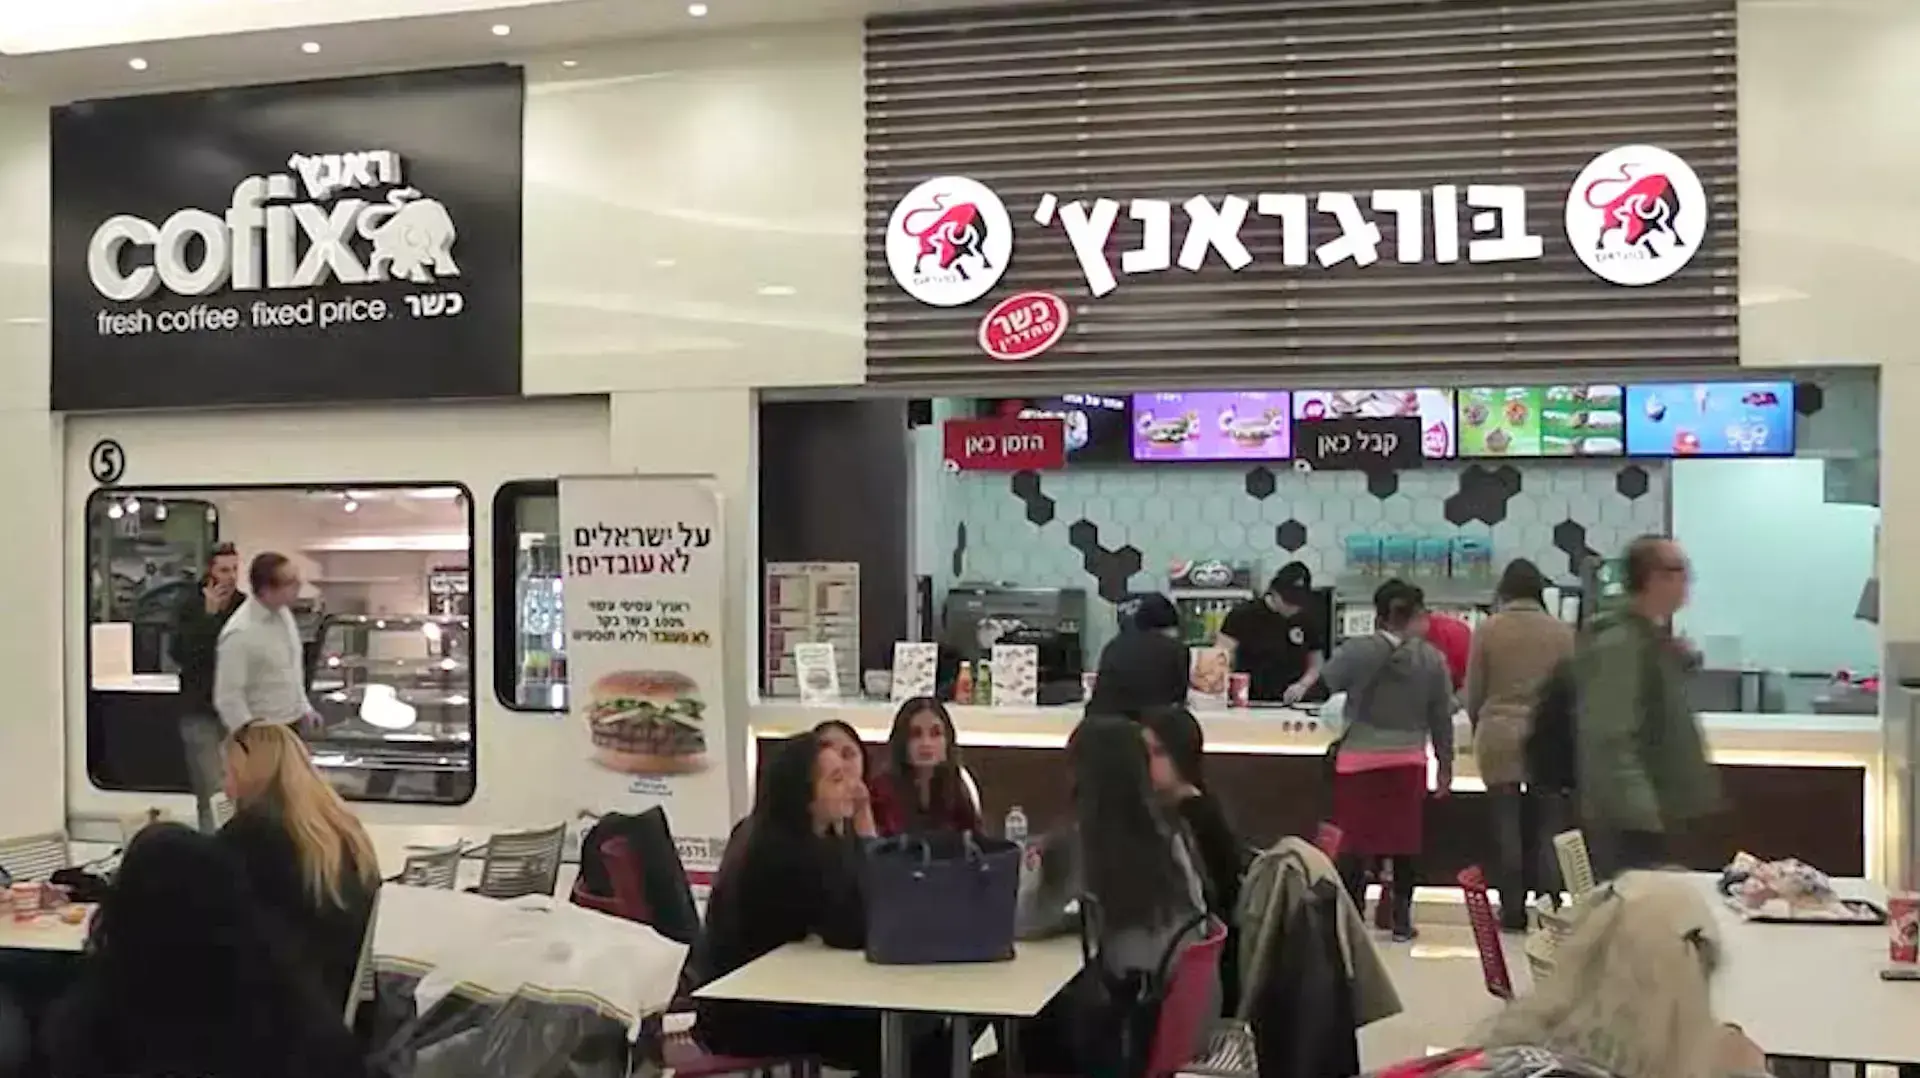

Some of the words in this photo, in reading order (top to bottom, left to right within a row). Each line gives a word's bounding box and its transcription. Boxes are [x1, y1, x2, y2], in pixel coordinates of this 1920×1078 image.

[87, 175, 371, 301] cofix
[1033, 184, 1544, 298] בורגראנץ'
[98, 309, 151, 335] fresh
[250, 298, 315, 327] fixed
[404, 292, 465, 319] כשר
[992, 300, 1051, 336] כשר
[965, 435, 995, 458] כאן
[1002, 434, 1044, 457] הזמן
[1318, 433, 1349, 458] כאן
[1355, 429, 1399, 457] קבל
[101, 448, 114, 477] 5
[574, 522, 672, 547] ישראלים
[678, 522, 711, 547] על
[567, 554, 655, 576] עובדים!
[660, 548, 690, 573] לא
